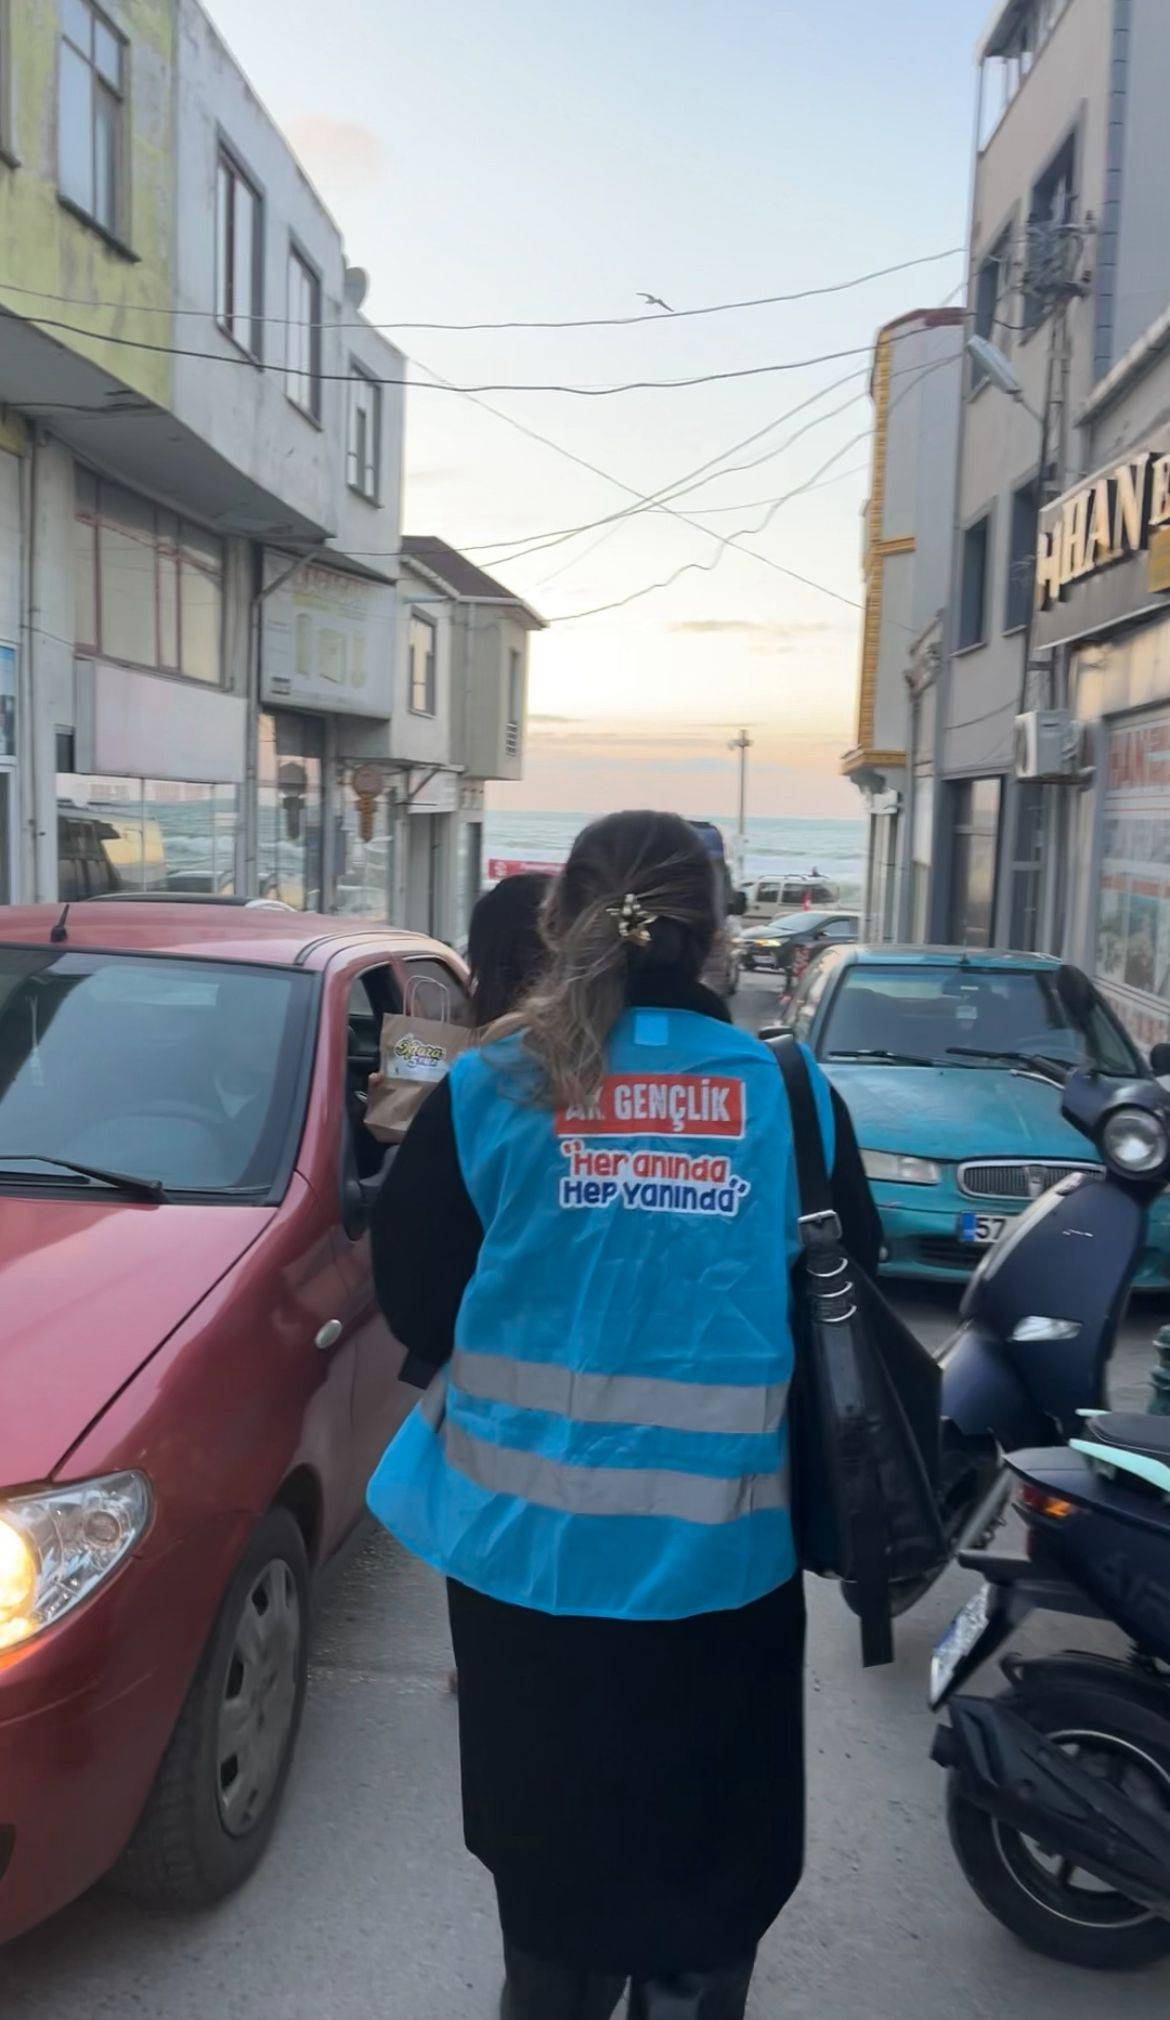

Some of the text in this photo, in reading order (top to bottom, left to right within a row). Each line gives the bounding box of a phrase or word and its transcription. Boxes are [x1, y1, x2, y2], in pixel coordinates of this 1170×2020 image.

[614, 1079, 731, 1132] GENÇLİK
[633, 1153, 727, 1183] anında
[976, 1217, 1007, 1240] 57
